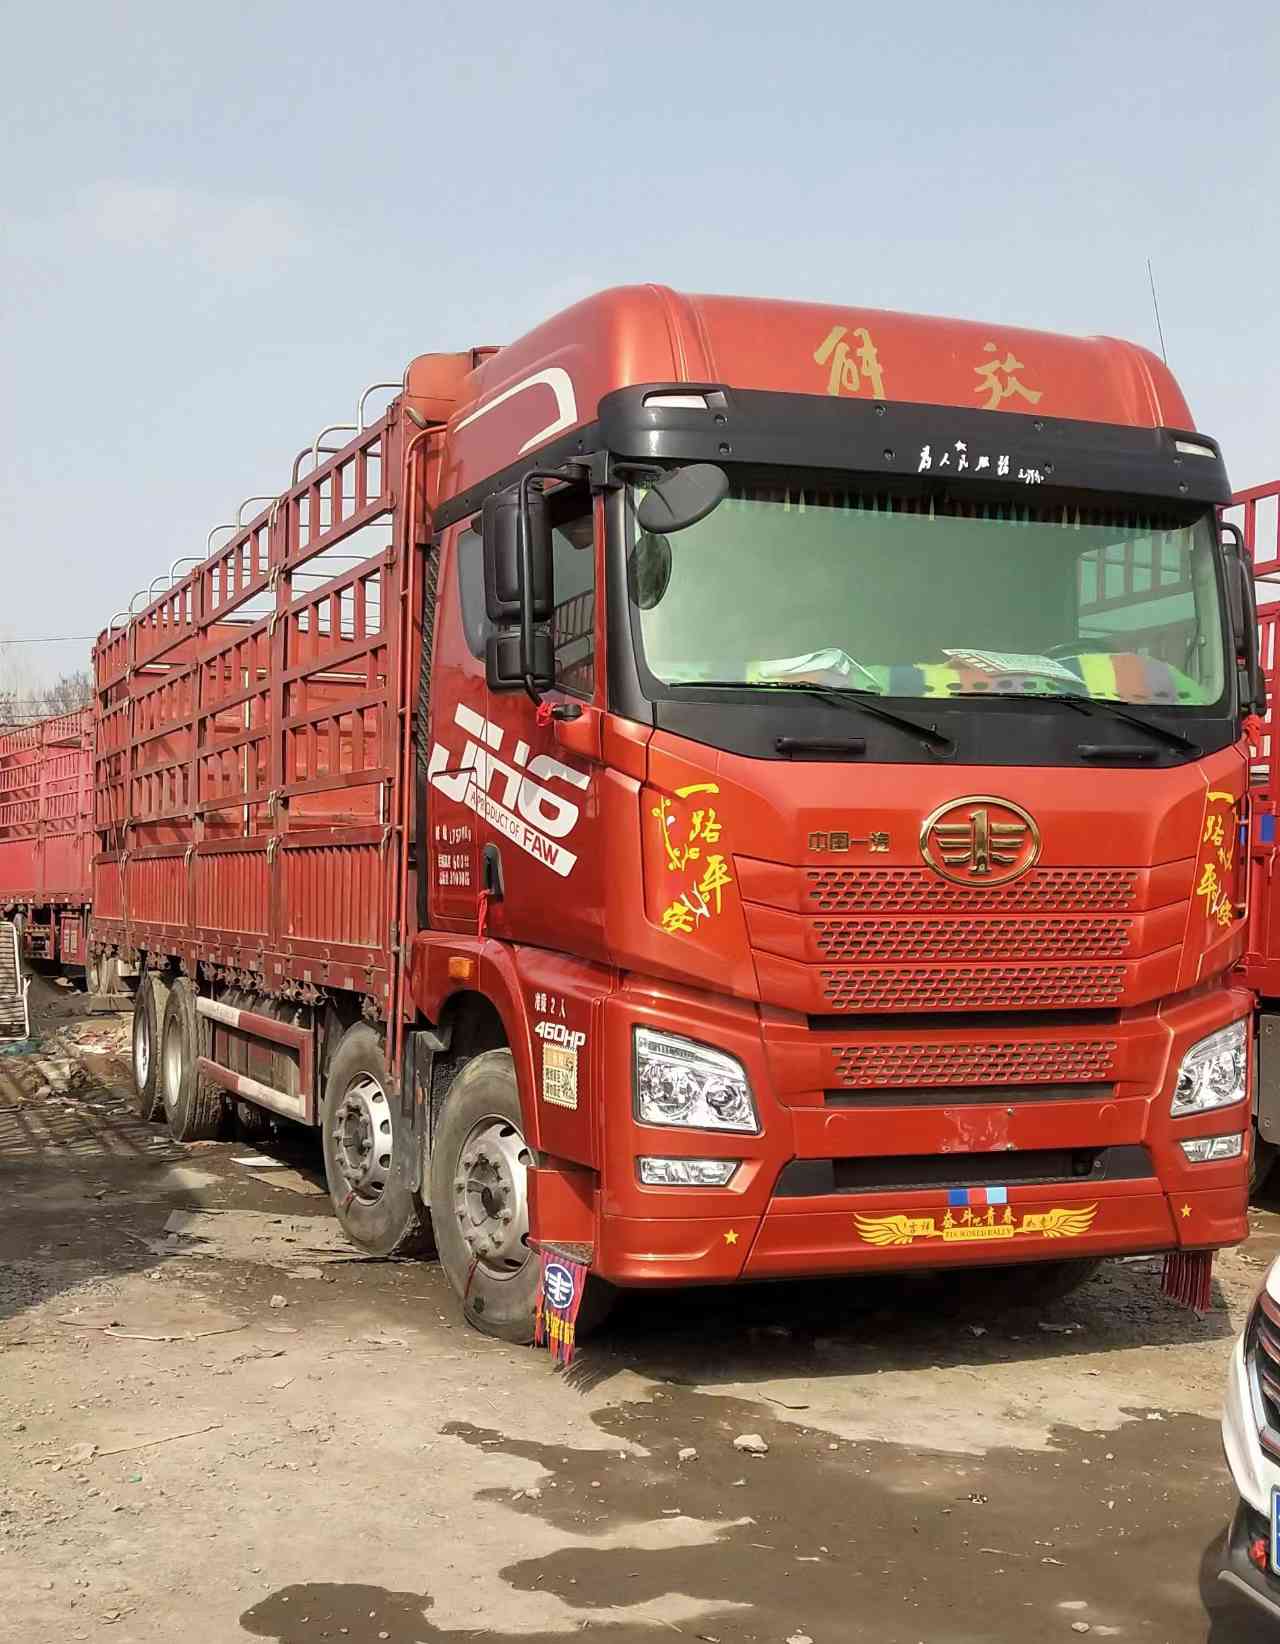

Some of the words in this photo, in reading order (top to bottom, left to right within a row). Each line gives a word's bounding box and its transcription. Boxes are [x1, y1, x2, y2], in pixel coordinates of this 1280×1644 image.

[814, 326, 1043, 410] 解放
[476, 794, 510, 831] PRODUCT
[509, 820, 521, 837] OF
[523, 827, 560, 866] FAW
[661, 783, 733, 933] 一路平安
[807, 831, 890, 852] 中国一汽
[534, 1021, 586, 1048] 460HP
